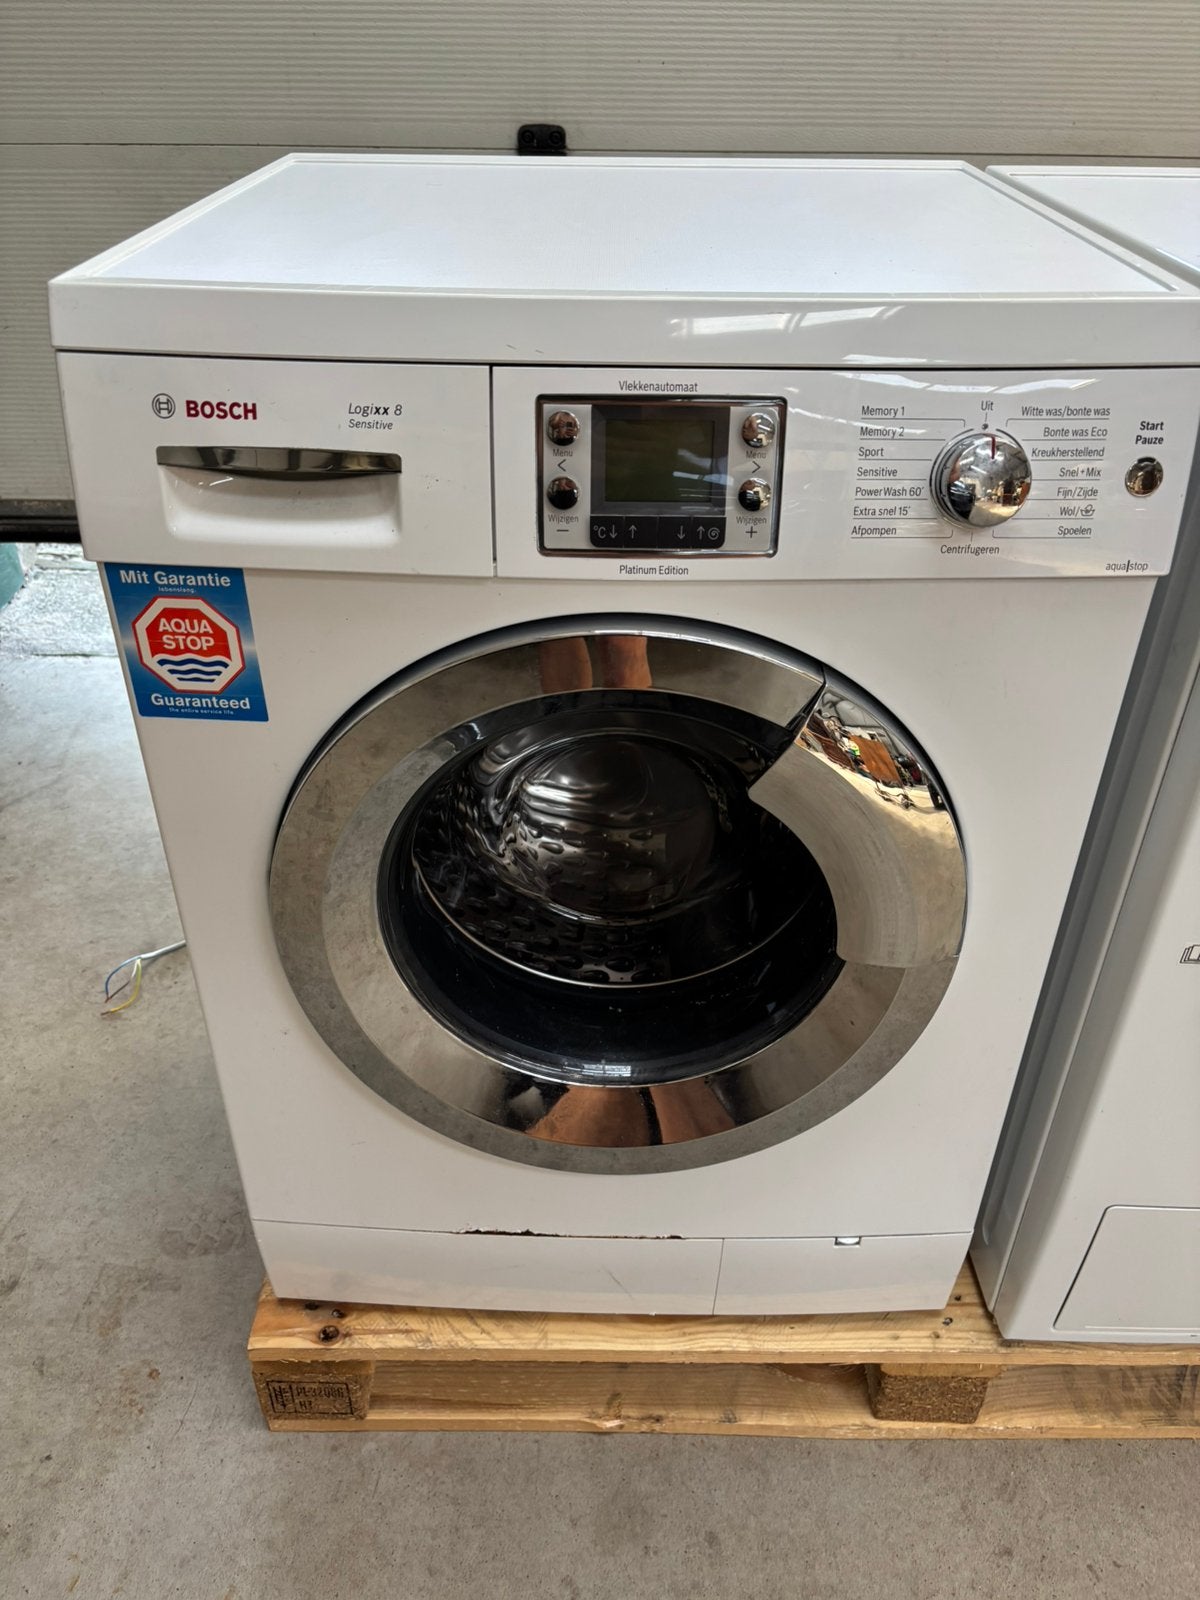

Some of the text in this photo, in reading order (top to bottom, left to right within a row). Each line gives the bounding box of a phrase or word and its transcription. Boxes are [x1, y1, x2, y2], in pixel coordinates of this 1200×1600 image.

[619, 380, 698, 393] Vlekkenautomaat
[185, 399, 258, 420] BOSCH
[348, 402, 403, 417] Logixx 8
[861, 405, 905, 417] Memory 1
[981, 400, 994, 411] Uit
[1021, 405, 1044, 416] Witte
[1093, 408, 1111, 416] was
[348, 419, 394, 431] Sensitive
[1139, 420, 1164, 431] Start
[860, 426, 905, 438] Memory 2
[1043, 426, 1108, 437] Bonte was Eco
[1135, 434, 1164, 445] Pauze
[552, 448, 573, 457] Menu
[746, 450, 767, 459] Menu
[858, 446, 884, 457] Sport
[1031, 447, 1105, 457] Kreukherstellend
[856, 466, 898, 477] Sensitive
[853, 506, 876, 516] Extra
[878, 506, 896, 516] snel
[548, 514, 579, 524] Wijzigen
[736, 516, 767, 526] Wijzigen
[851, 525, 897, 537] Afpompen
[1058, 526, 1092, 537] Spoelen
[940, 544, 1000, 556] Centrifugeren
[619, 565, 689, 575] Platinum Edition
[119, 569, 231, 587] Mit Garantie
[158, 618, 214, 634] AQUA
[162, 635, 215, 651] STOP
[151, 693, 251, 710] Guaranteed
